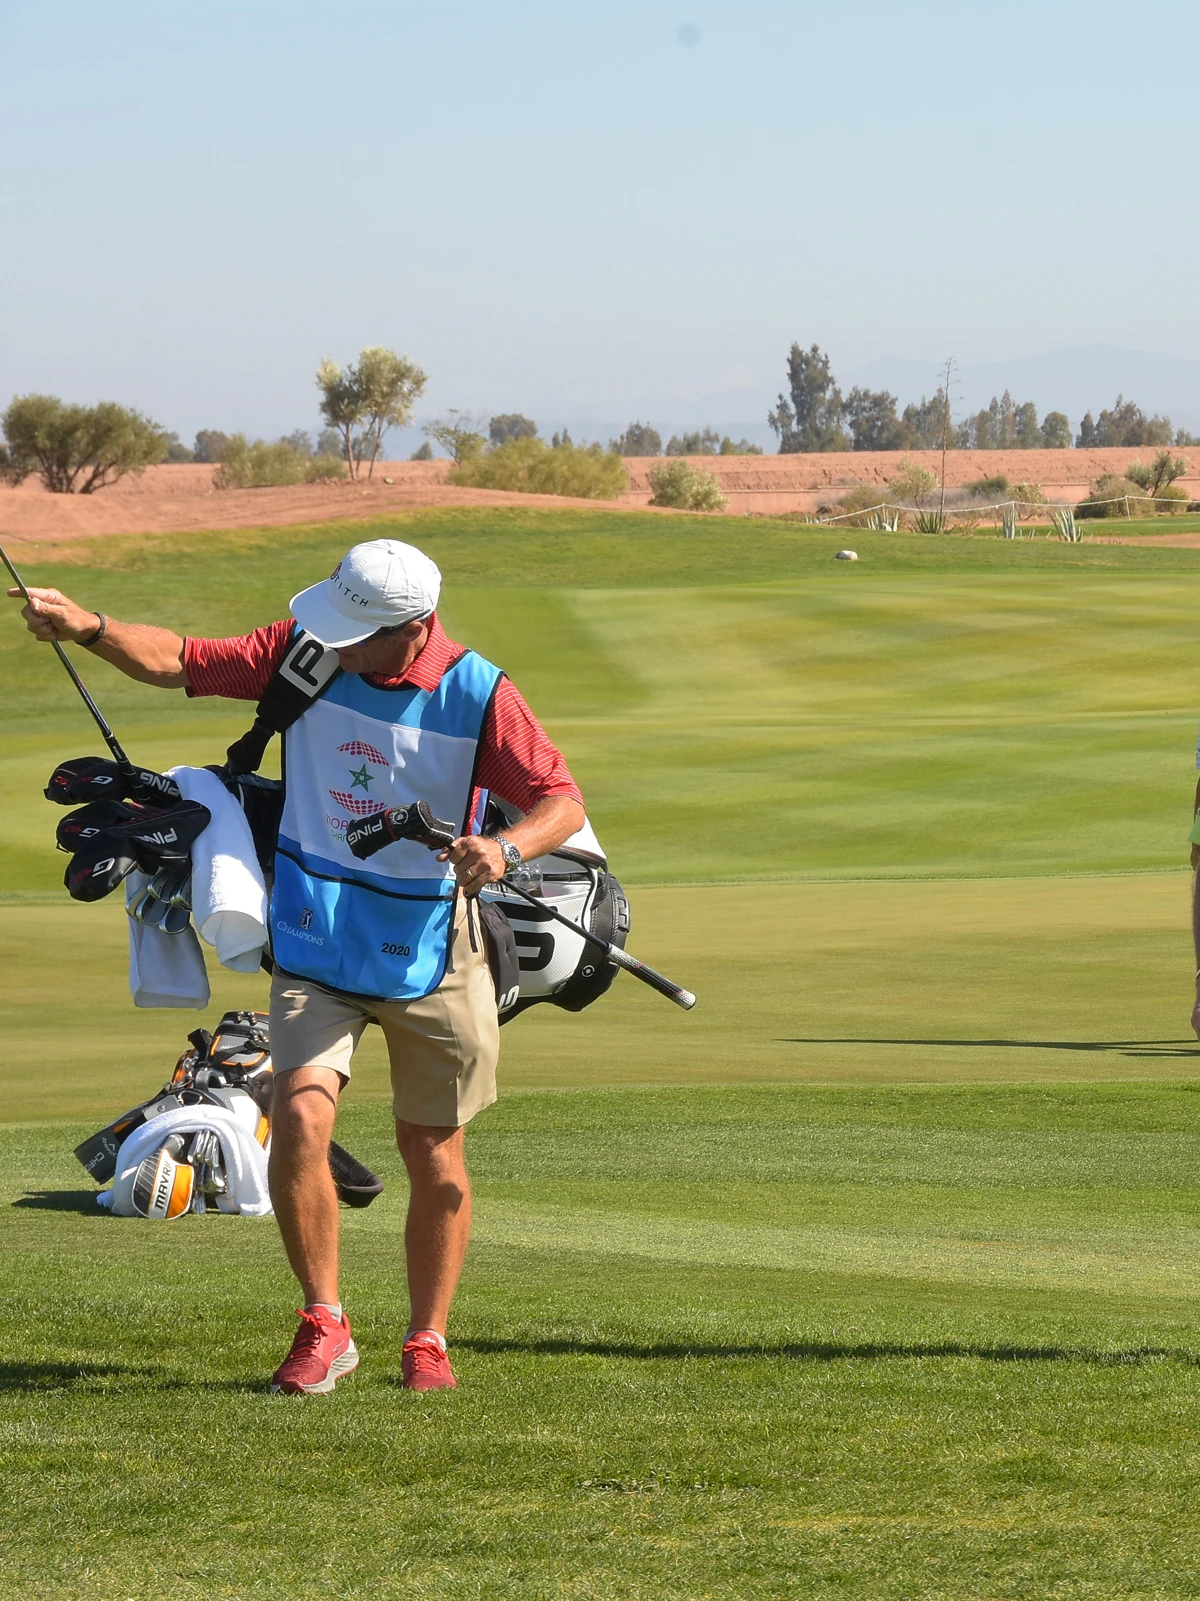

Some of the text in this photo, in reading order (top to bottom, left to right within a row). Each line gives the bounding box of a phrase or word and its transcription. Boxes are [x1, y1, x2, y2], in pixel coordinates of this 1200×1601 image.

[347, 819, 384, 845] PING
[276, 920, 325, 946] CHAMPIONS
[381, 942, 411, 957] 2020
